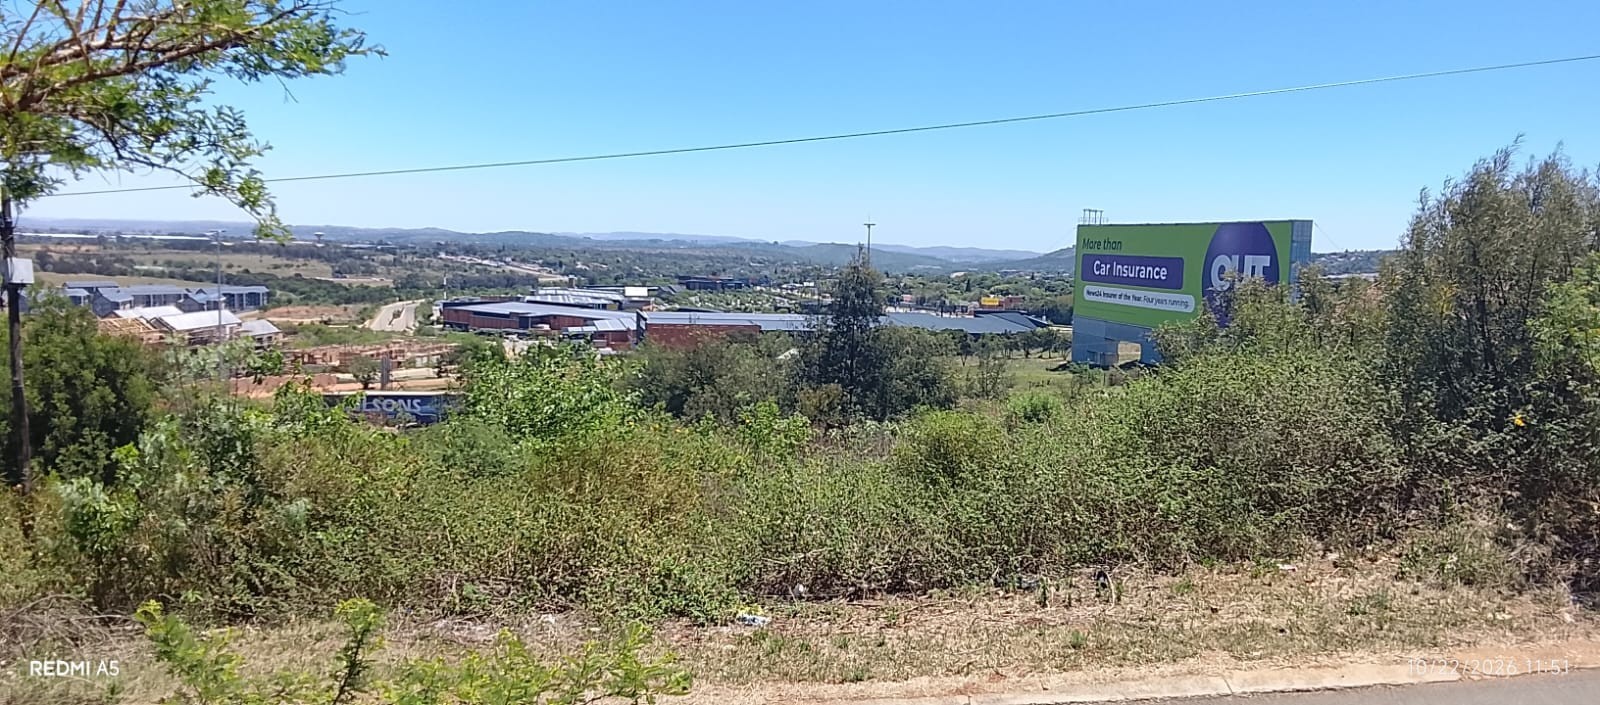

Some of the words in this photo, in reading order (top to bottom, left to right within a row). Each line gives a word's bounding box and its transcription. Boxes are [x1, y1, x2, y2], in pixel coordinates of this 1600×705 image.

[1082, 238, 1101, 250] More
[1103, 237, 1122, 251] than
[1093, 260, 1111, 276] Car
[1112, 261, 1168, 280] Insurance
[1102, 290, 1118, 299] Insurer
[1123, 293, 1131, 301] the
[1143, 295, 1154, 304] Four
[1153, 297, 1168, 306] years
